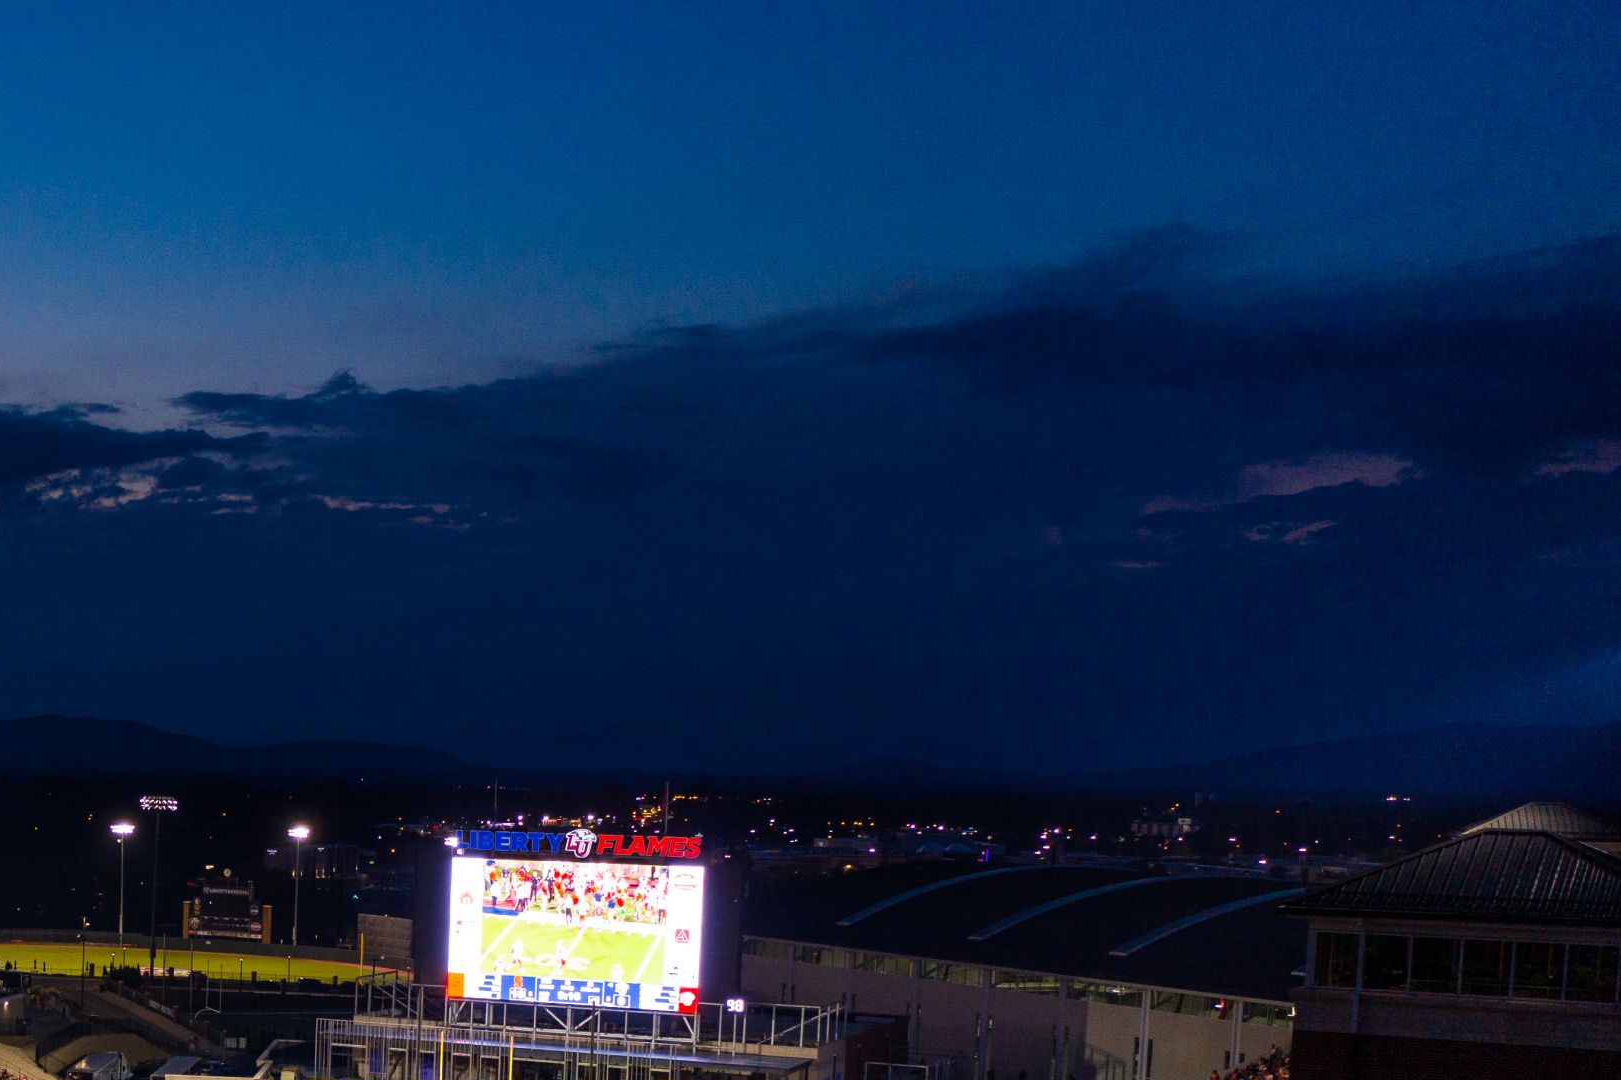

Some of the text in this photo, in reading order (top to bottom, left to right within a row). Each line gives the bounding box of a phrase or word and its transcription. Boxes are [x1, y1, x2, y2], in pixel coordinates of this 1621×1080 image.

[455, 830, 567, 853] LIBERTY
[596, 834, 702, 858] FLAMES
[513, 976, 523, 988] S
[727, 999, 744, 1012] 98
